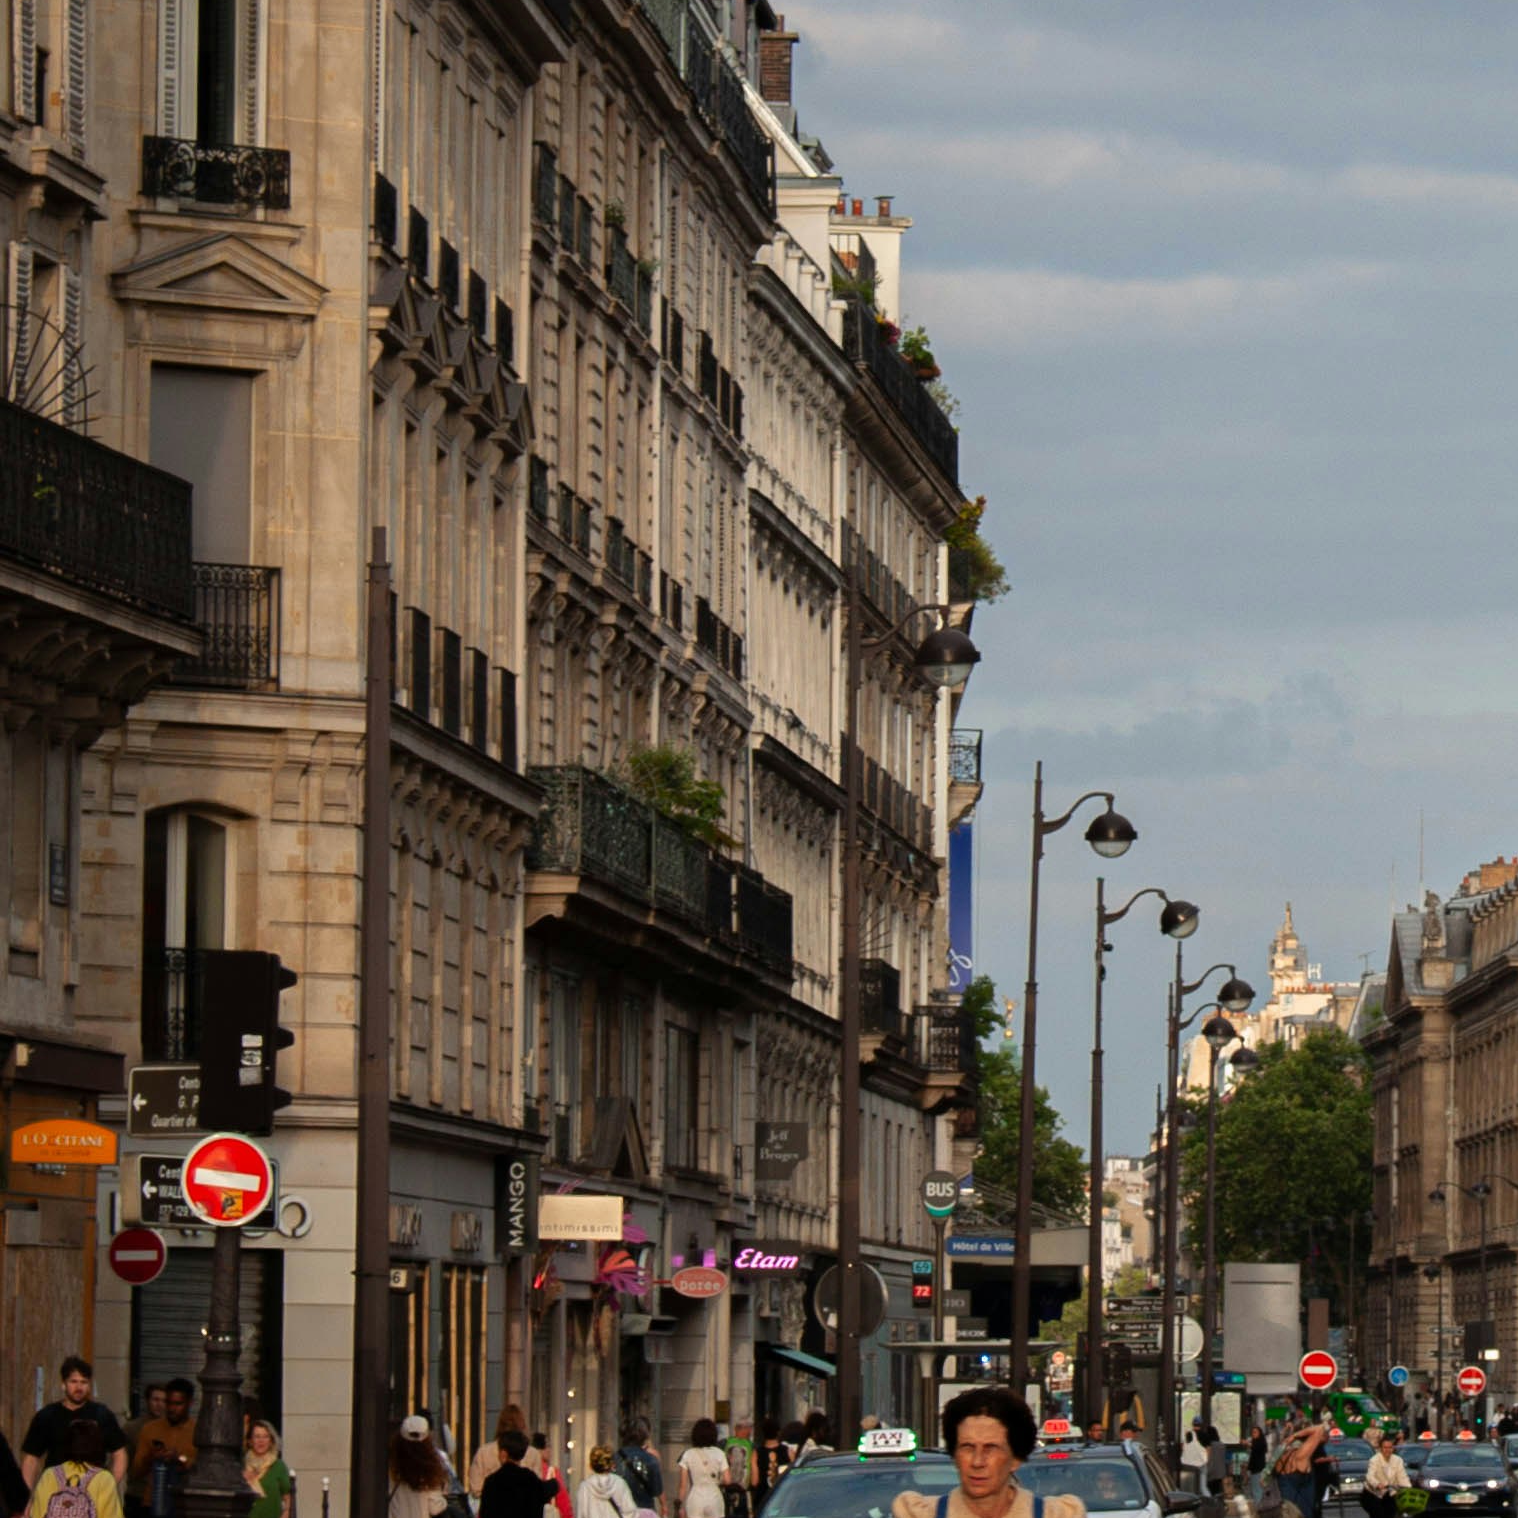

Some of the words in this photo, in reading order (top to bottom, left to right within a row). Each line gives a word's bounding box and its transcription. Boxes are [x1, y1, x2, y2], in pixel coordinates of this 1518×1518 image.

[179, 1076, 201, 1090] Cent
[151, 1114, 184, 1128] Quartier
[186, 1114, 197, 1128] de
[22, 1132, 102, 1148] LOCITANE
[768, 1129, 790, 1144] Jeff
[759, 1148, 800, 1162] Bruges
[159, 1164, 182, 1180] Cent
[159, 1185, 182, 1199] WALL
[926, 1182, 954, 1197] BUS
[508, 1162, 526, 1247] MANGO
[539, 1223, 619, 1233] intimissimi
[952, 1240, 978, 1252] Hôtel
[980, 1241, 992, 1252] de
[994, 1241, 1015, 1252] Ville
[734, 1248, 799, 1269] Etam
[914, 1261, 931, 1273] 69
[914, 1286, 930, 1297] 72
[871, 1431, 903, 1441] TAXI
